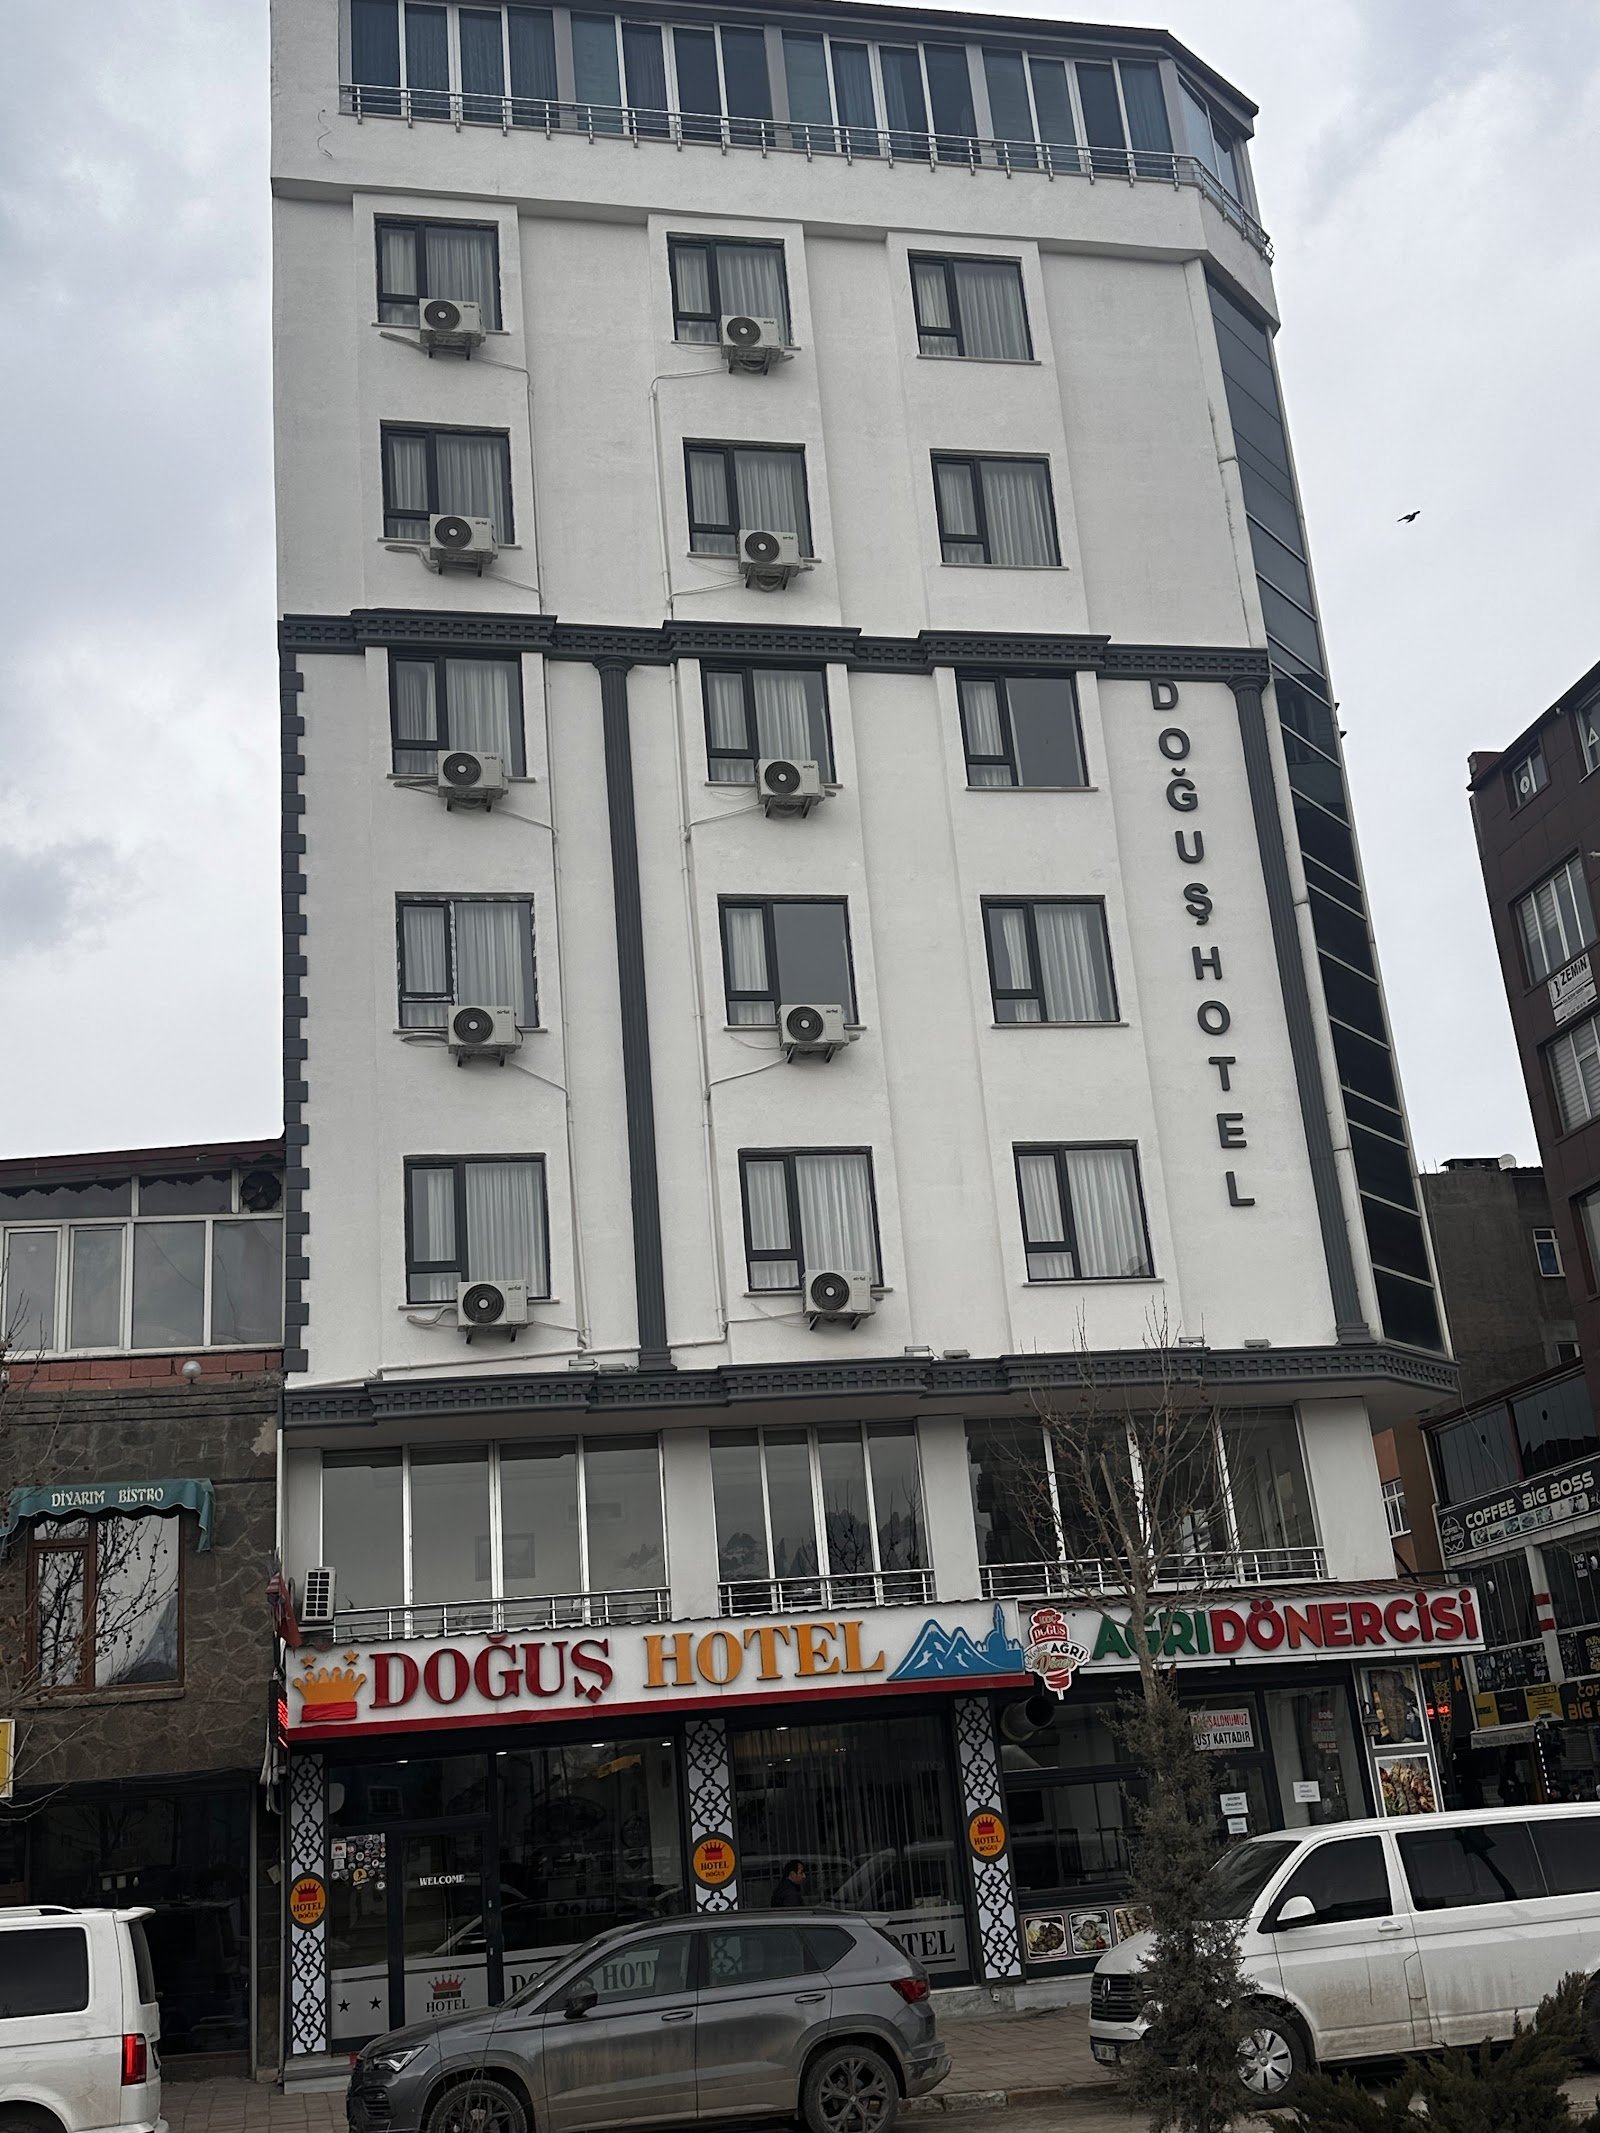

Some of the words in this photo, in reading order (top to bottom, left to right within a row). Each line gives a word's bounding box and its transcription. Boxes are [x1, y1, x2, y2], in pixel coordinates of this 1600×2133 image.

[1150, 677, 1213, 926] DOĞUŞ
[1191, 946, 1256, 1207] HOTEL
[51, 1490, 106, 1507] DİYARIM
[118, 1486, 165, 1504] BİSTRO
[1465, 1498, 1517, 1529] COFFEE
[1549, 1470, 1595, 1499] BOSS
[1210, 1589, 1480, 1653] DÖNERCİSİ
[1050, 1642, 1085, 1660] AĞRI
[369, 1632, 614, 1709] DOĞUŞ
[642, 1620, 885, 1688] HOTEL
[1208, 1713, 1249, 1728] SALONUMUZ
[974, 1836, 1001, 1845] HOTEL
[701, 1861, 729, 1871] HOTEL
[418, 1874, 465, 1887] WELCOME
[293, 1902, 323, 1913] HOTEL
[890, 1930, 955, 1957] TEL
[602, 1960, 656, 1990] HOT
[426, 1998, 470, 2013] HOTEL
